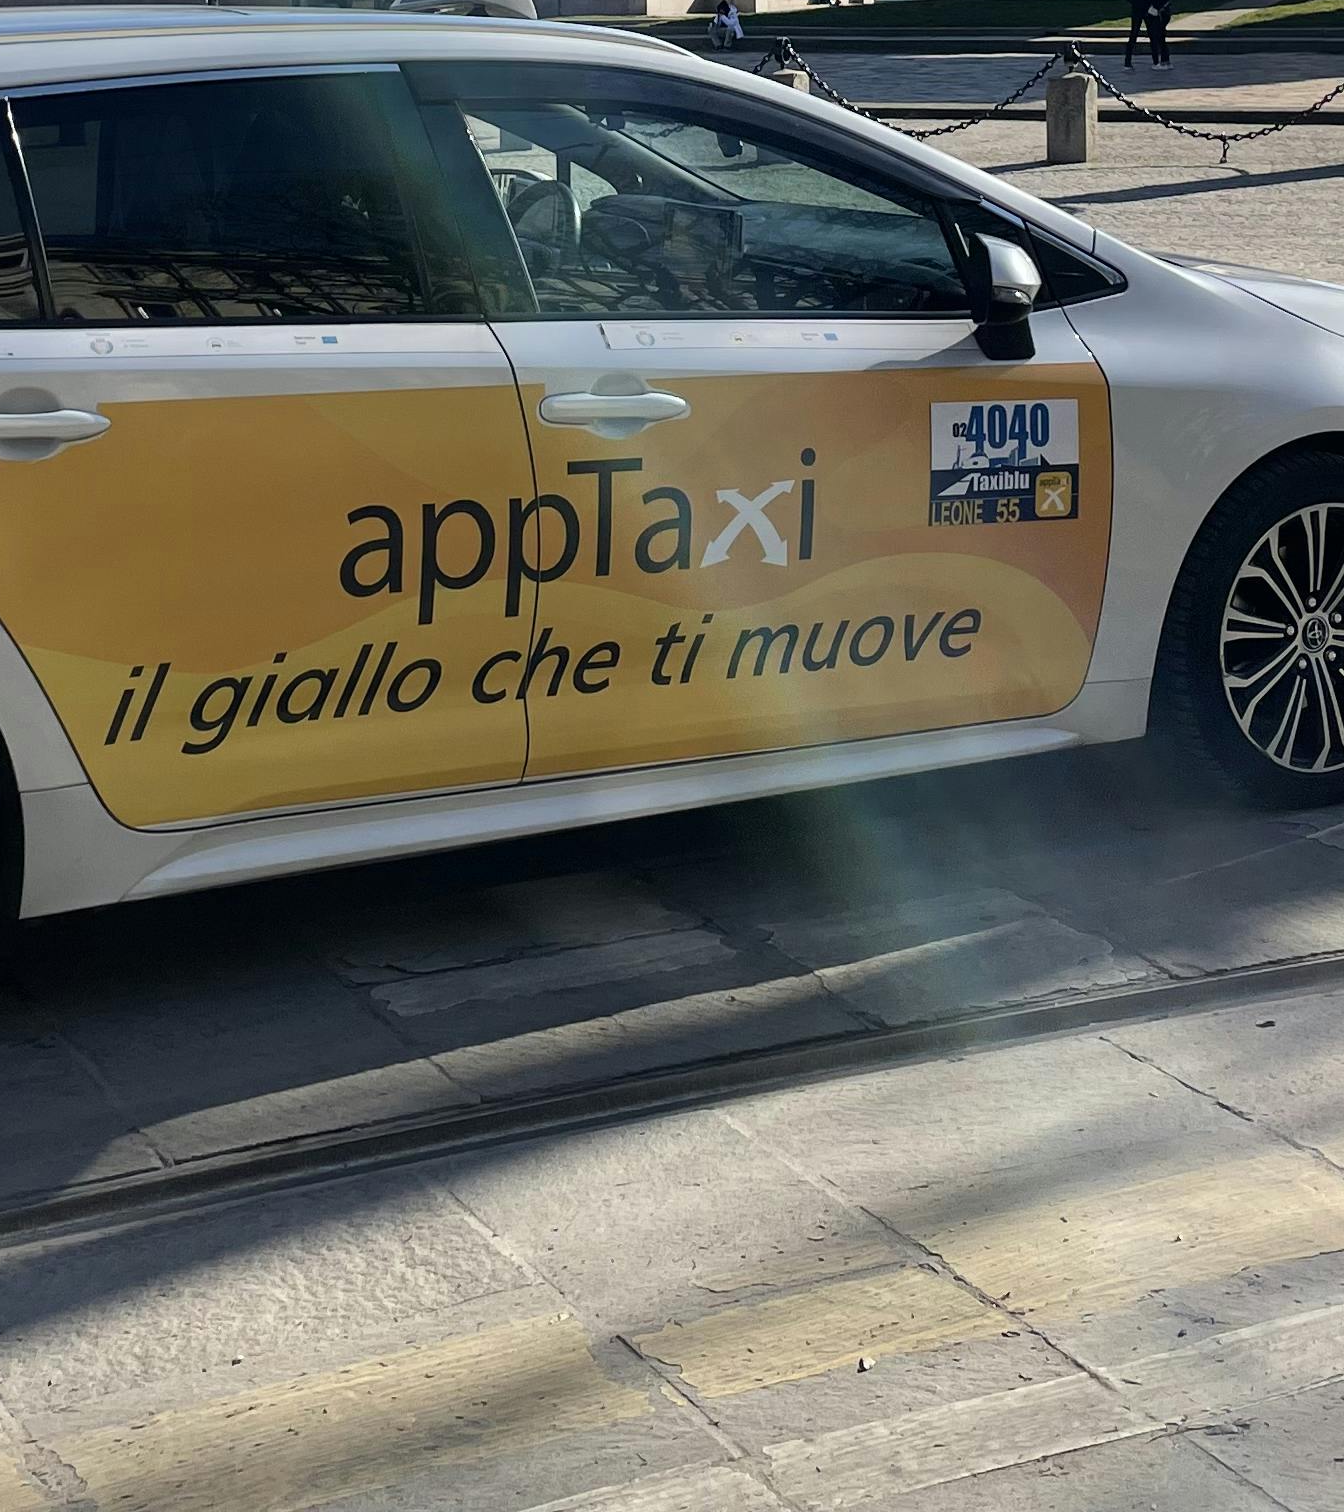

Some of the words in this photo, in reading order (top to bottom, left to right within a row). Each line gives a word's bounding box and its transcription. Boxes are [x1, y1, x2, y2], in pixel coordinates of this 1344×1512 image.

[952, 422, 967, 438] 02
[965, 403, 1050, 462] 4040
[971, 470, 1031, 492] Taxiblu
[339, 447, 816, 625] appTaxi
[931, 499, 983, 526] LEONE
[996, 499, 1021, 523] 55
[104, 662, 171, 746] il
[181, 641, 443, 755] giallo
[471, 627, 621, 704] che
[650, 613, 714, 686] ti
[725, 607, 982, 680] muove
